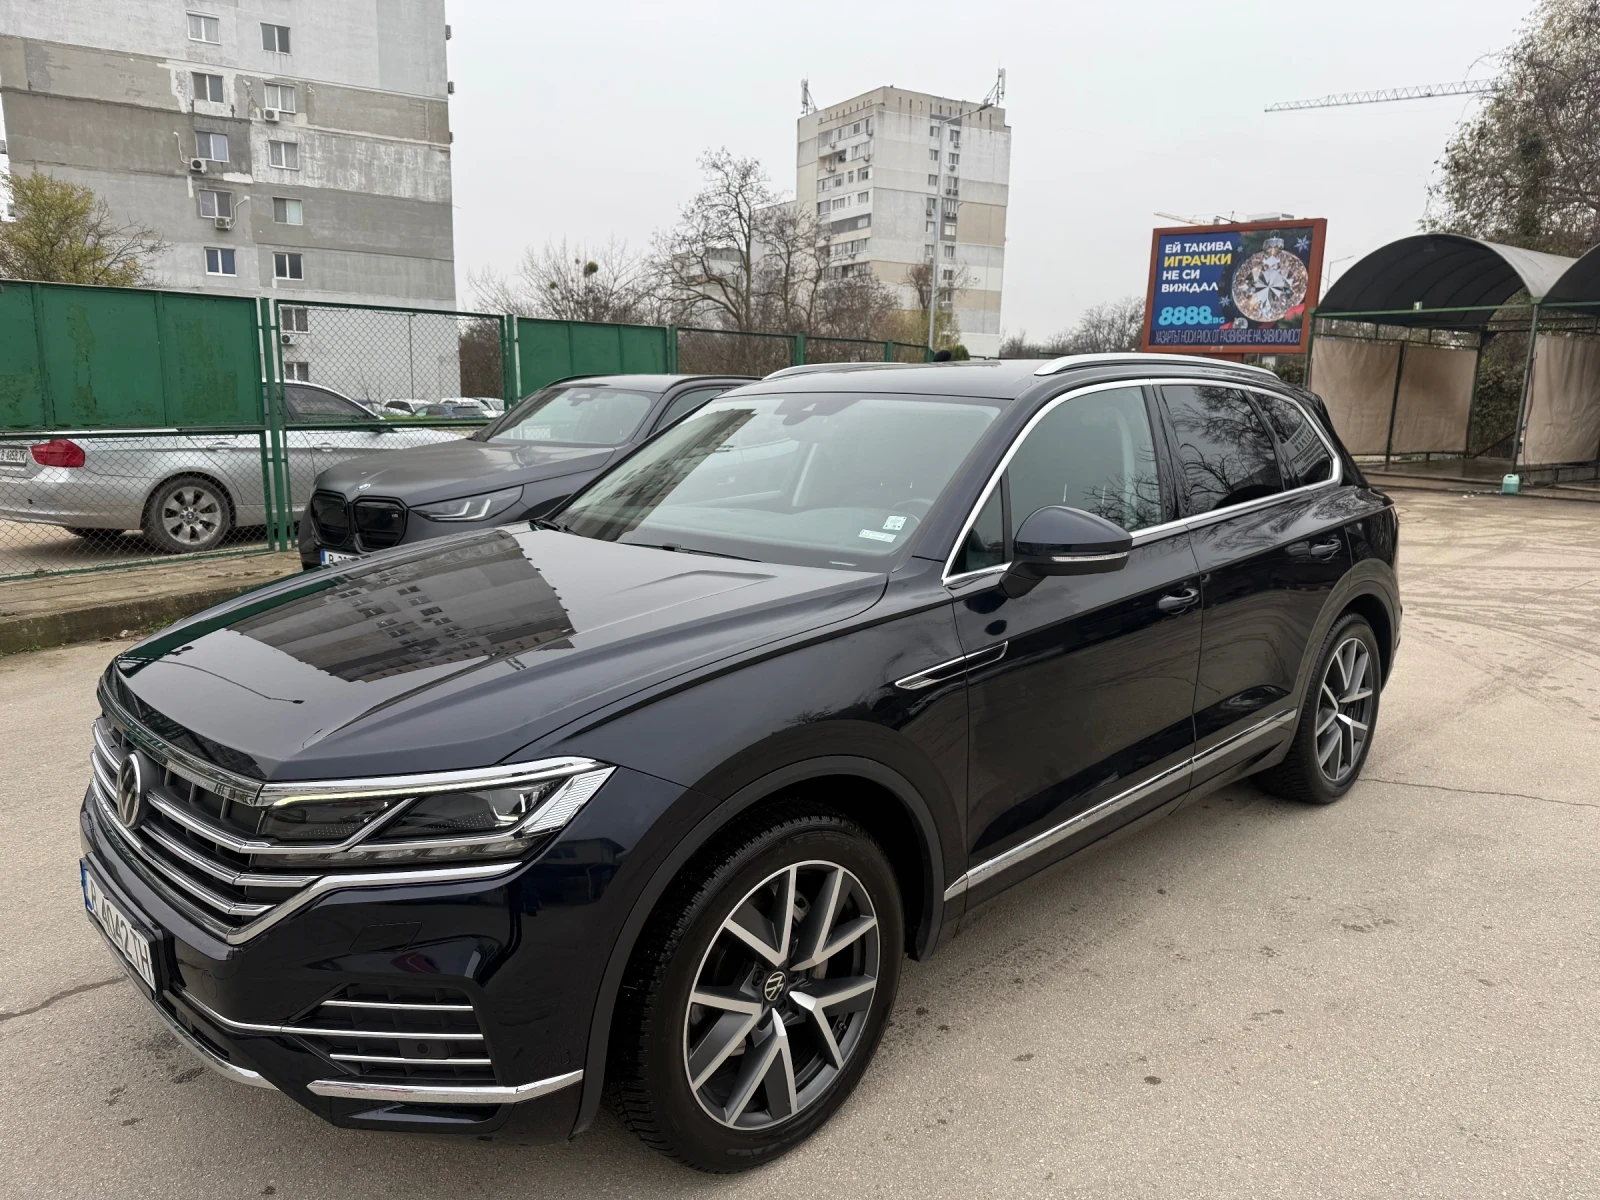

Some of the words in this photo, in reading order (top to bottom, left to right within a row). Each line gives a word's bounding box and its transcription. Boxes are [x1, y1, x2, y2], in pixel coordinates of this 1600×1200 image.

[1165, 241, 1181, 254] ЕЙ
[1184, 241, 1233, 253] ТАКИВА
[1164, 253, 1232, 267] ИГРАЧКИ
[1162, 270, 1180, 281] НЕ
[1182, 269, 1201, 280] СИ
[1161, 282, 1219, 293] ВИЖДАЛ
[129, 929, 152, 982] TH
